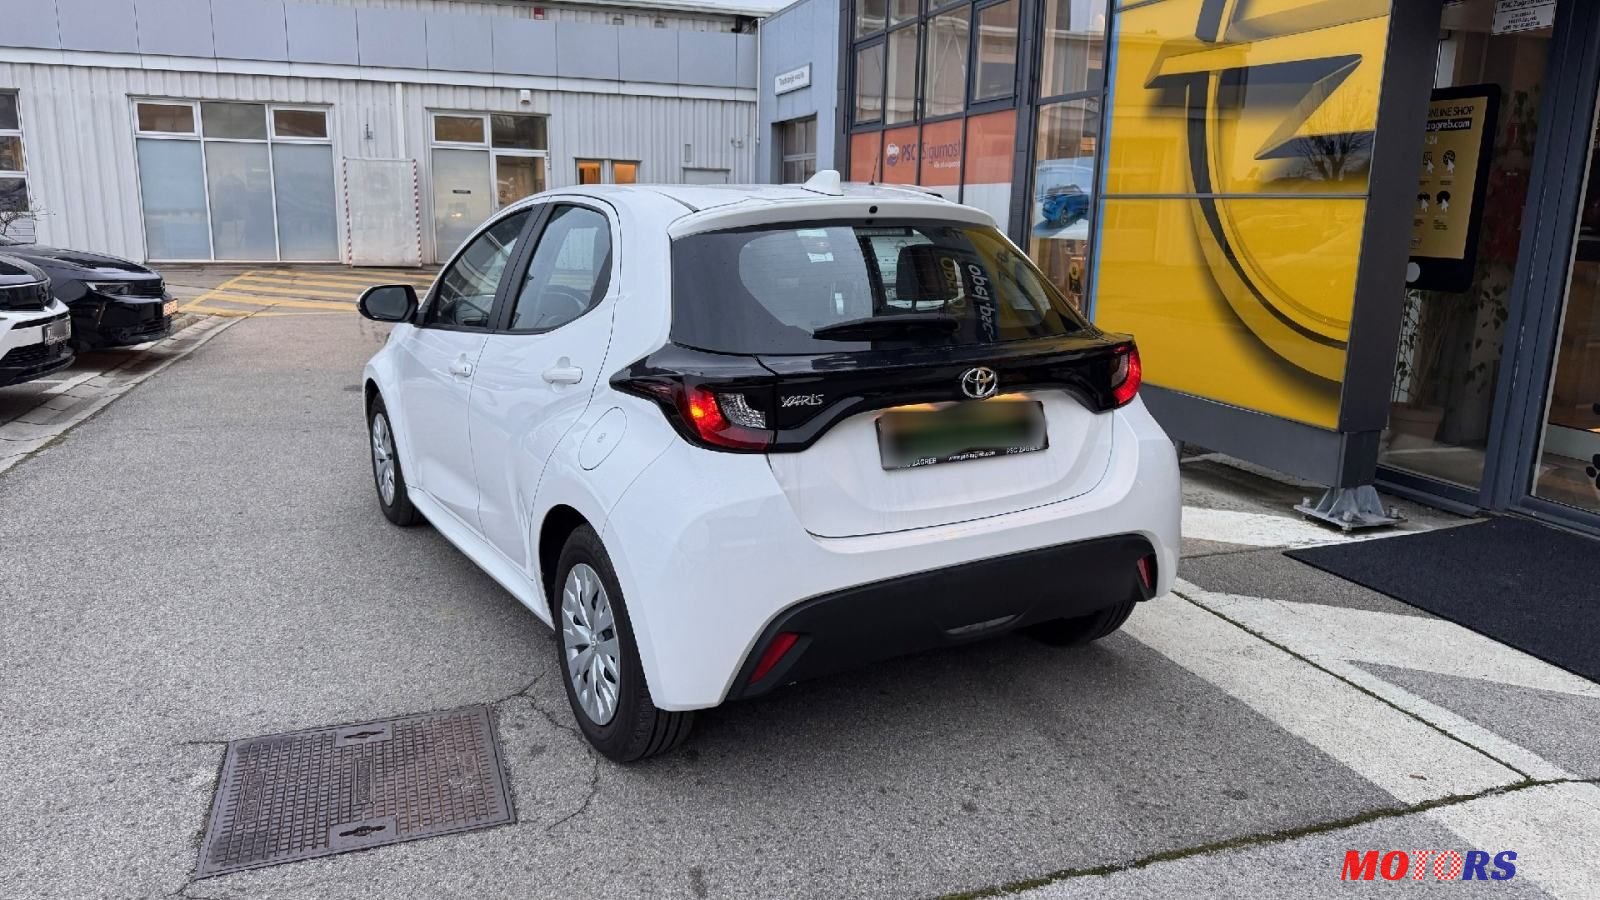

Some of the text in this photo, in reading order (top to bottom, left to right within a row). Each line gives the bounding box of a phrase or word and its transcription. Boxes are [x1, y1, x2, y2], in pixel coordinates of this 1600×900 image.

[1453, 105, 1474, 116] SHOP
[901, 143, 917, 163] PSC
[781, 394, 824, 407] YARIS
